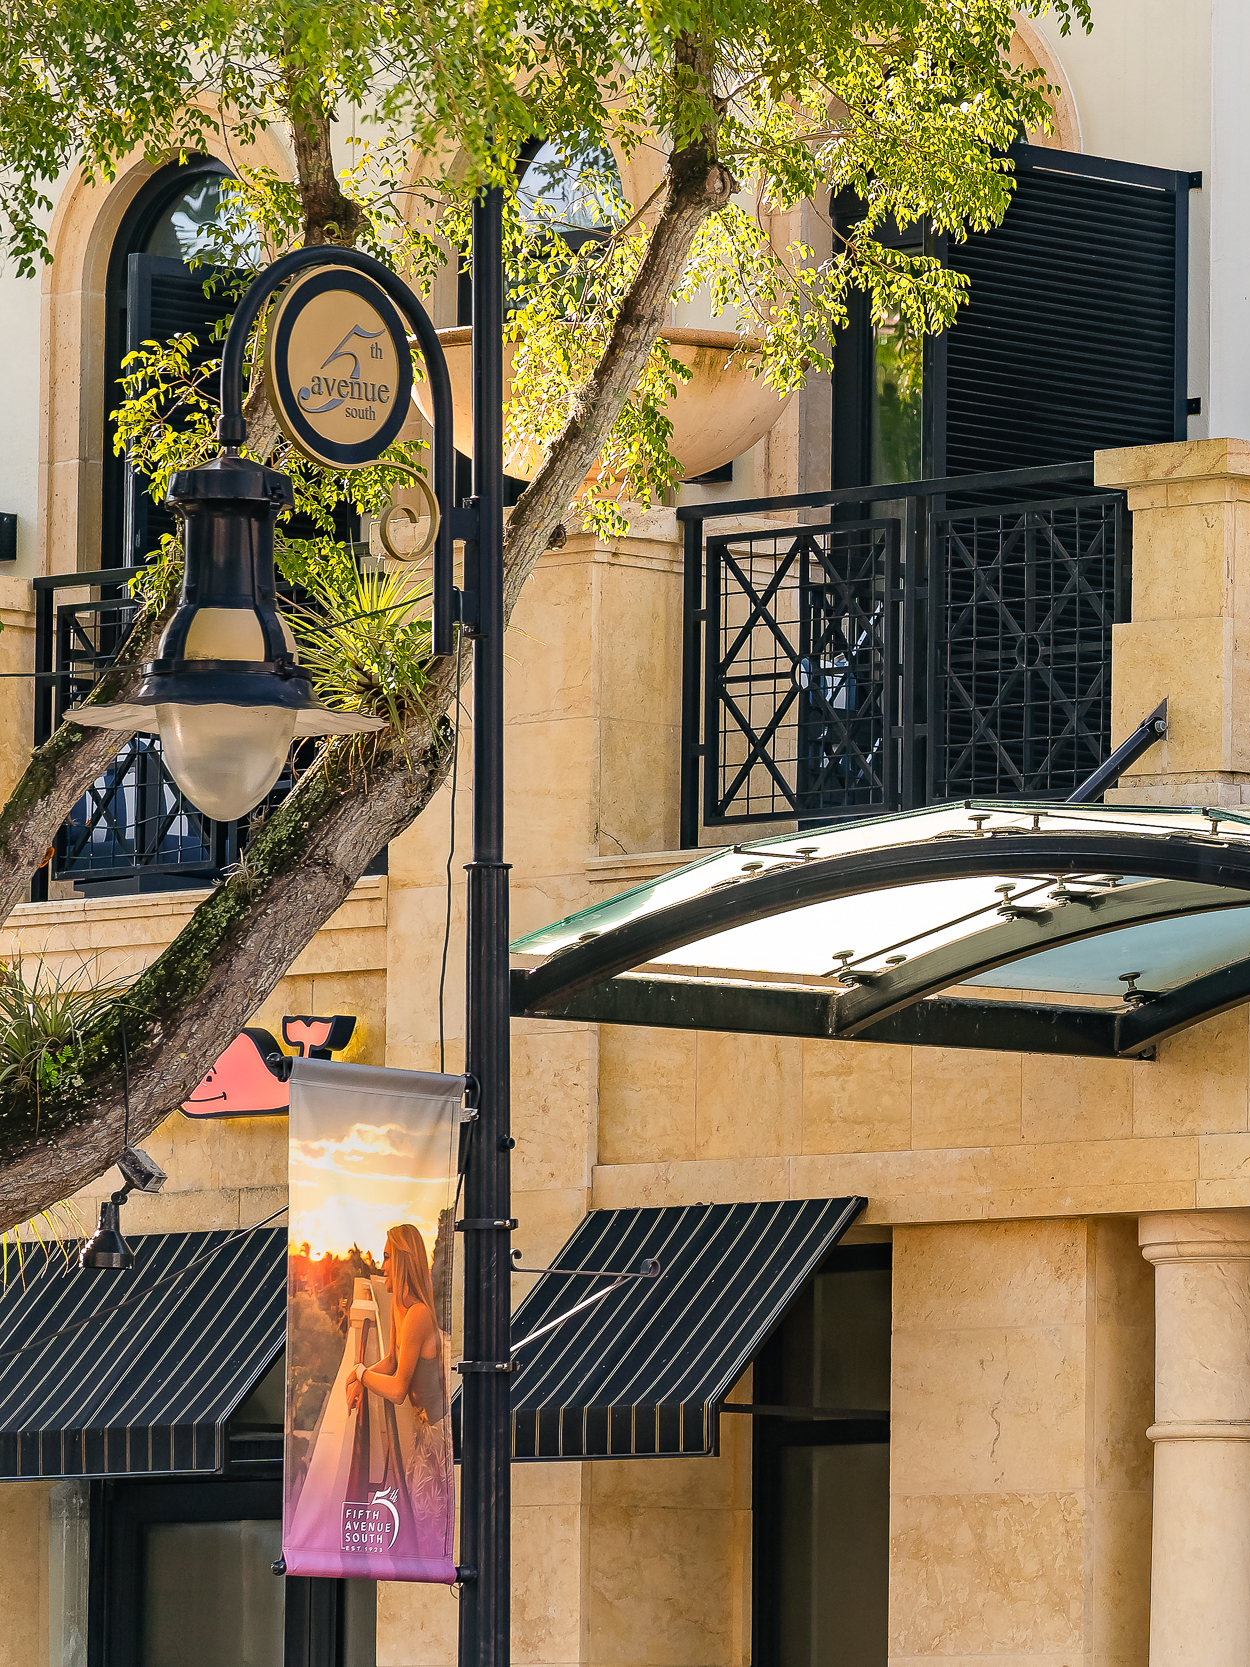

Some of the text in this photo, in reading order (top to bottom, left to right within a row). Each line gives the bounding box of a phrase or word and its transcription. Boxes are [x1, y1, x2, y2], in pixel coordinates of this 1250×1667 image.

[311, 375, 390, 404] avenue
[345, 406, 377, 421] south
[345, 1509, 380, 1520] FIFTH
[344, 1520, 392, 1533] AVENUE
[344, 1532, 383, 1544] SOUTH
